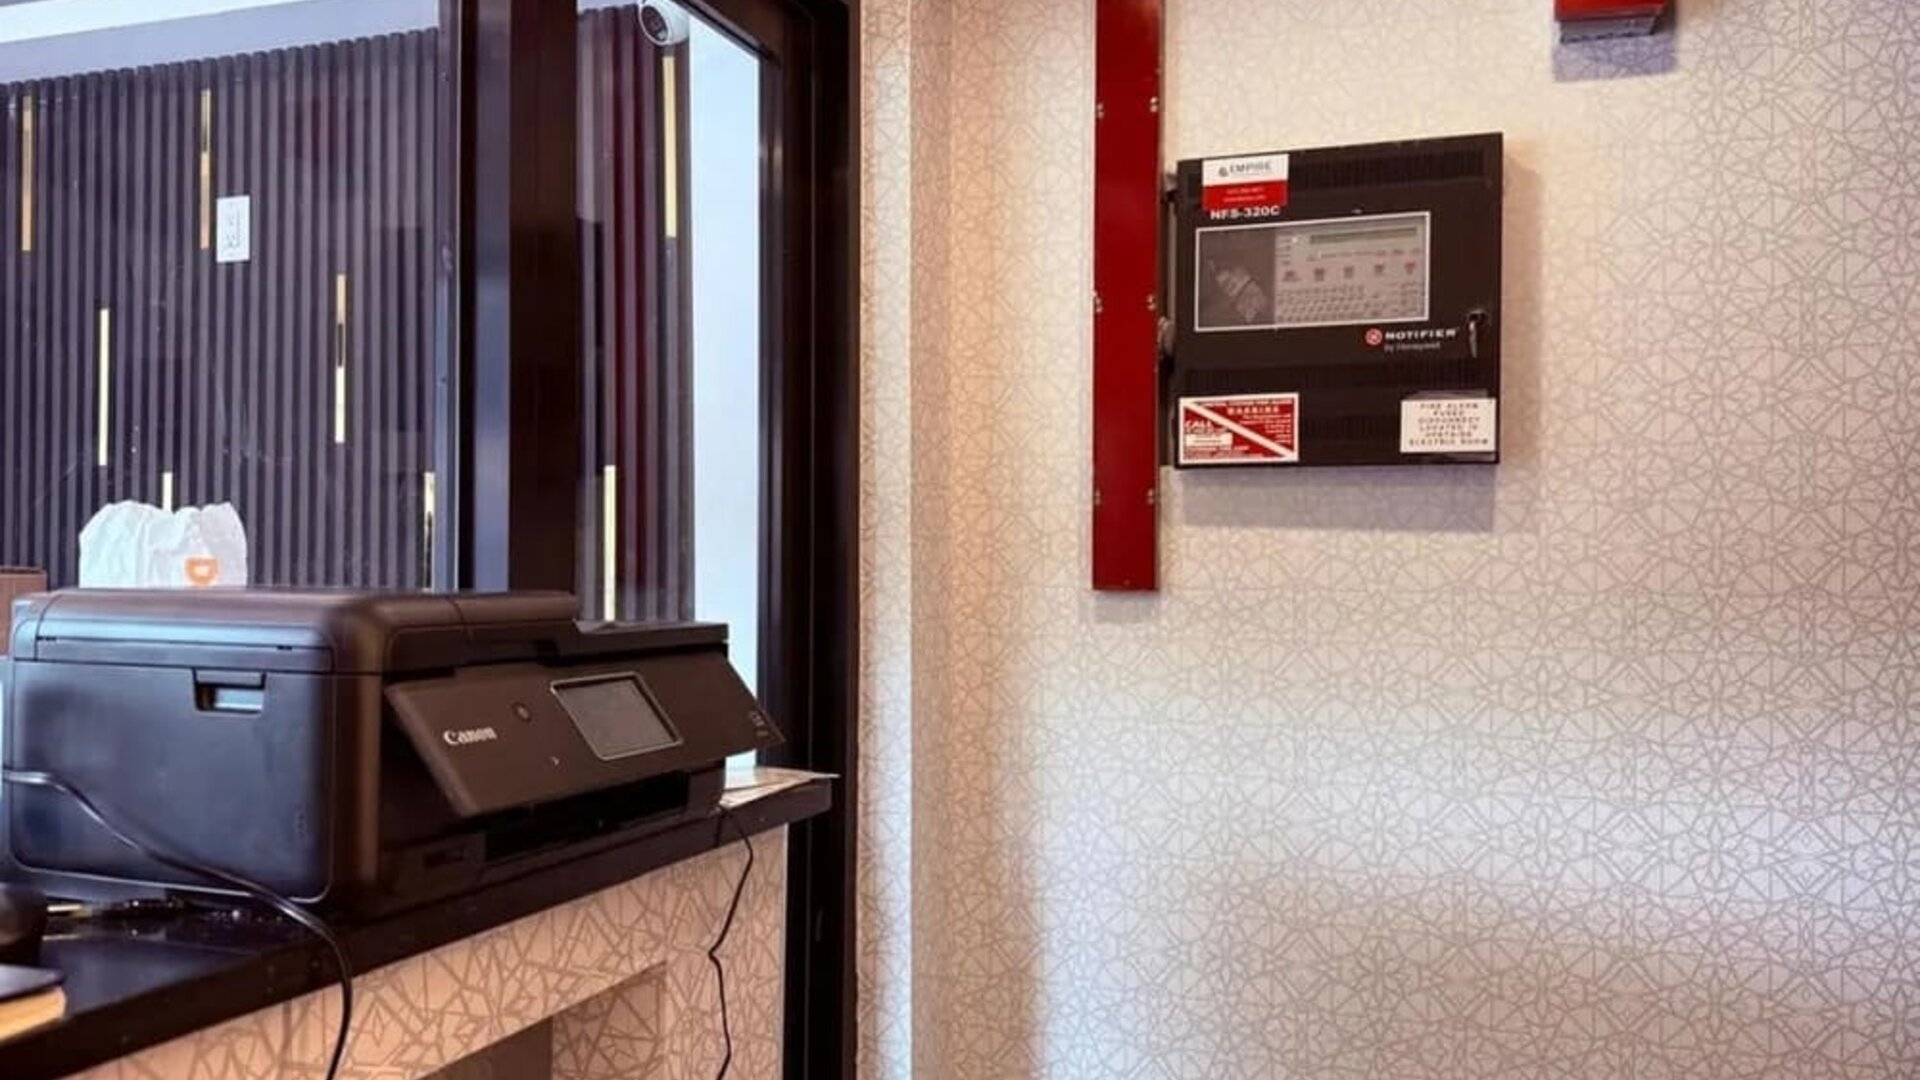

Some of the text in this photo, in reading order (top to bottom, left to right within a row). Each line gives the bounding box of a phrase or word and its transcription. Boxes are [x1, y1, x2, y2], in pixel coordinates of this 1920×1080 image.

[1229, 160, 1274, 173] EMPIRE
[1209, 204, 1281, 220] NFS-320C
[1385, 328, 1457, 340] NOTIFIER
[442, 726, 497, 745] Canon
